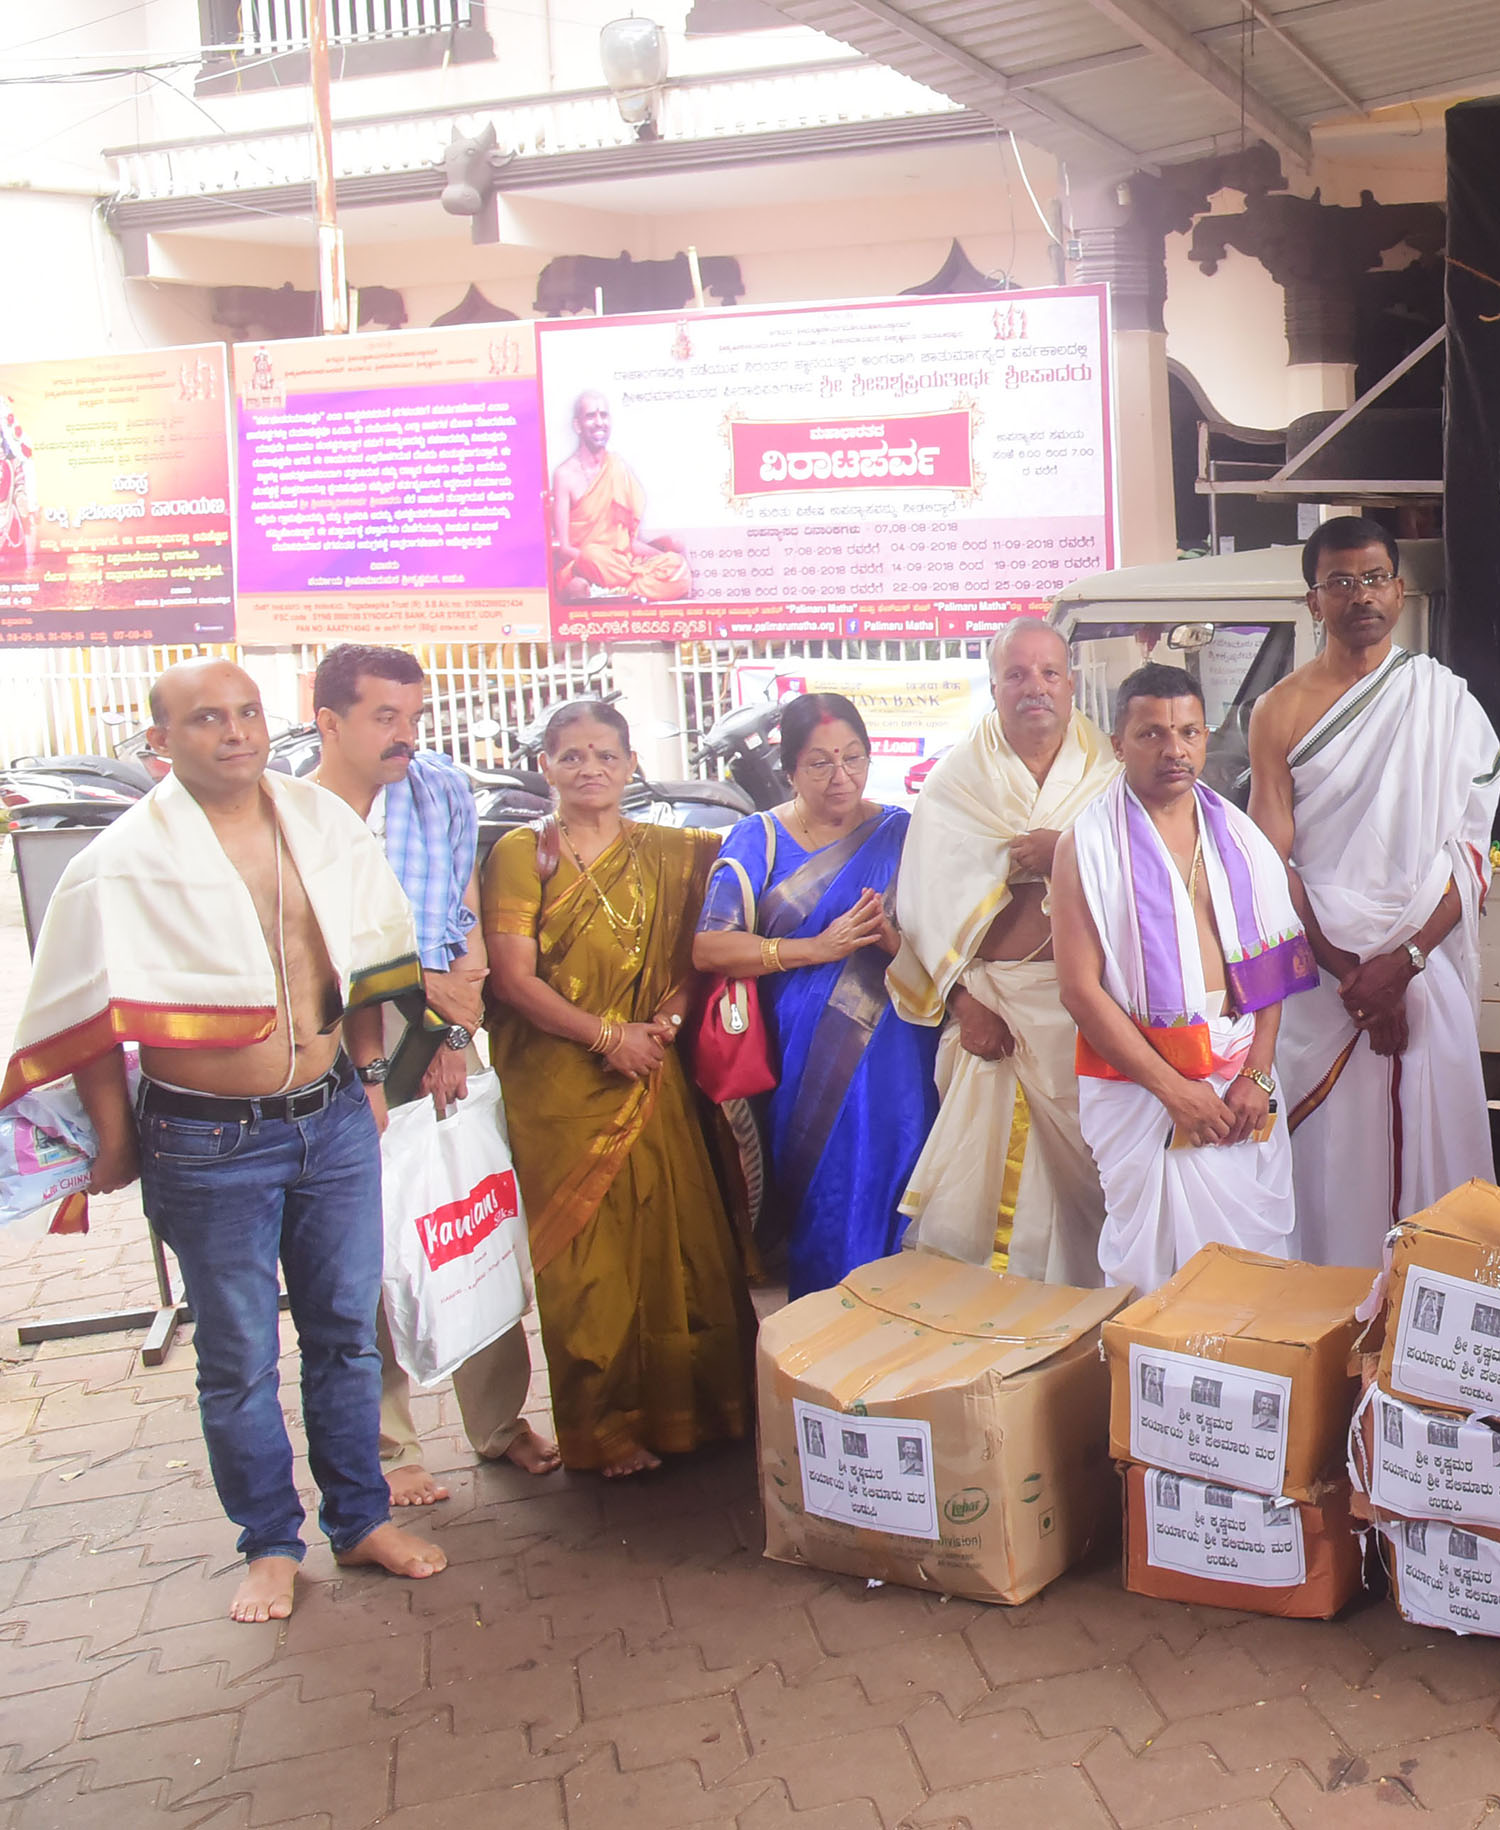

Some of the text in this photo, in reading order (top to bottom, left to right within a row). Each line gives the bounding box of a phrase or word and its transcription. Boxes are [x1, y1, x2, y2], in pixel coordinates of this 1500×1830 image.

[819, 375, 843, 400] ಶ್ರೀ
[1005, 364, 1093, 390] ಶ್ರೀಪಾದರು
[759, 438, 942, 482] ವಿರಾಟಪರ್ವ
[151, 497, 225, 518] ಪಾರಾಯಣ
[863, 619, 935, 632] Palimaru Matha
[849, 694, 941, 708] JAYA BANK
[883, 738, 918, 755] Loan
[1453, 1336, 1468, 1355] ಶ್ರೀ
[1407, 1346, 1456, 1371] ಪರ್ಯಾಯ
[1460, 1361, 1475, 1379] ಶ್ರೀ
[1460, 1385, 1494, 1402] ಉಡುಪಿ
[1178, 1408, 1233, 1434] ಶ್ರೀ ಕೃಷ್ಣಮಠ
[1141, 1416, 1275, 1460] ಪರ್ಯಾಯ ಶ್ರೀ ಪಲಿಮಾರು ಮಠ
[1189, 1451, 1219, 1467] ಉಡುಪಿ
